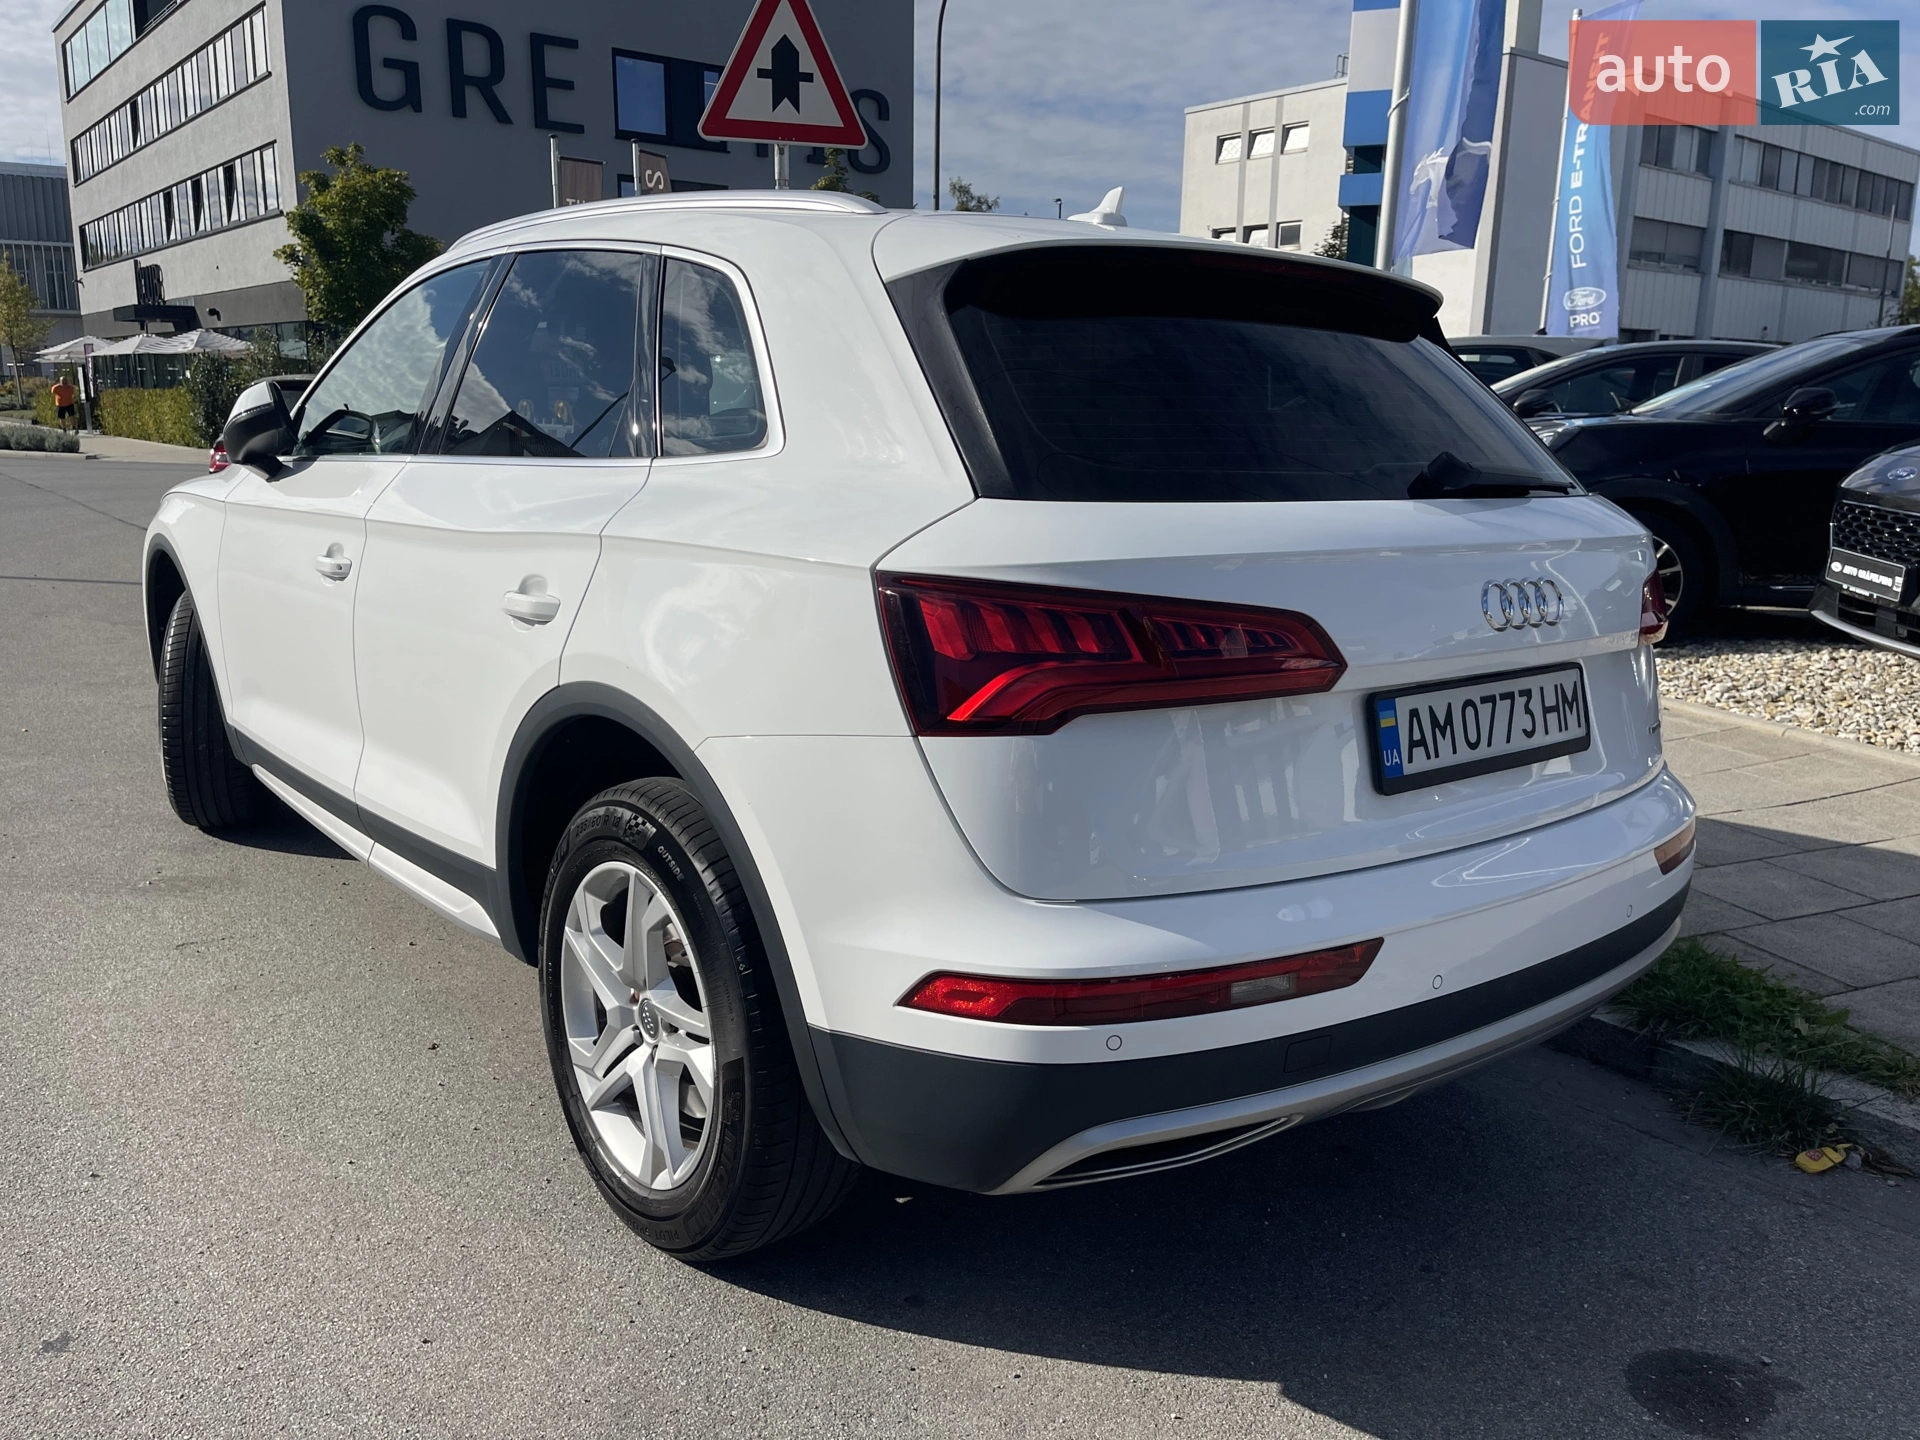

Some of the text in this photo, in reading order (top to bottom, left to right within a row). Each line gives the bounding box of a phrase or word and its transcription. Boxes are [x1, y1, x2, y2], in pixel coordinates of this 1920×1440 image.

[1568, 195, 1588, 269] FORD
[1569, 312, 1600, 328] PRO
[1406, 680, 1583, 765] AM0773HM
[1383, 749, 1401, 768] UA
[657, 845, 686, 882] OUTSIDE
